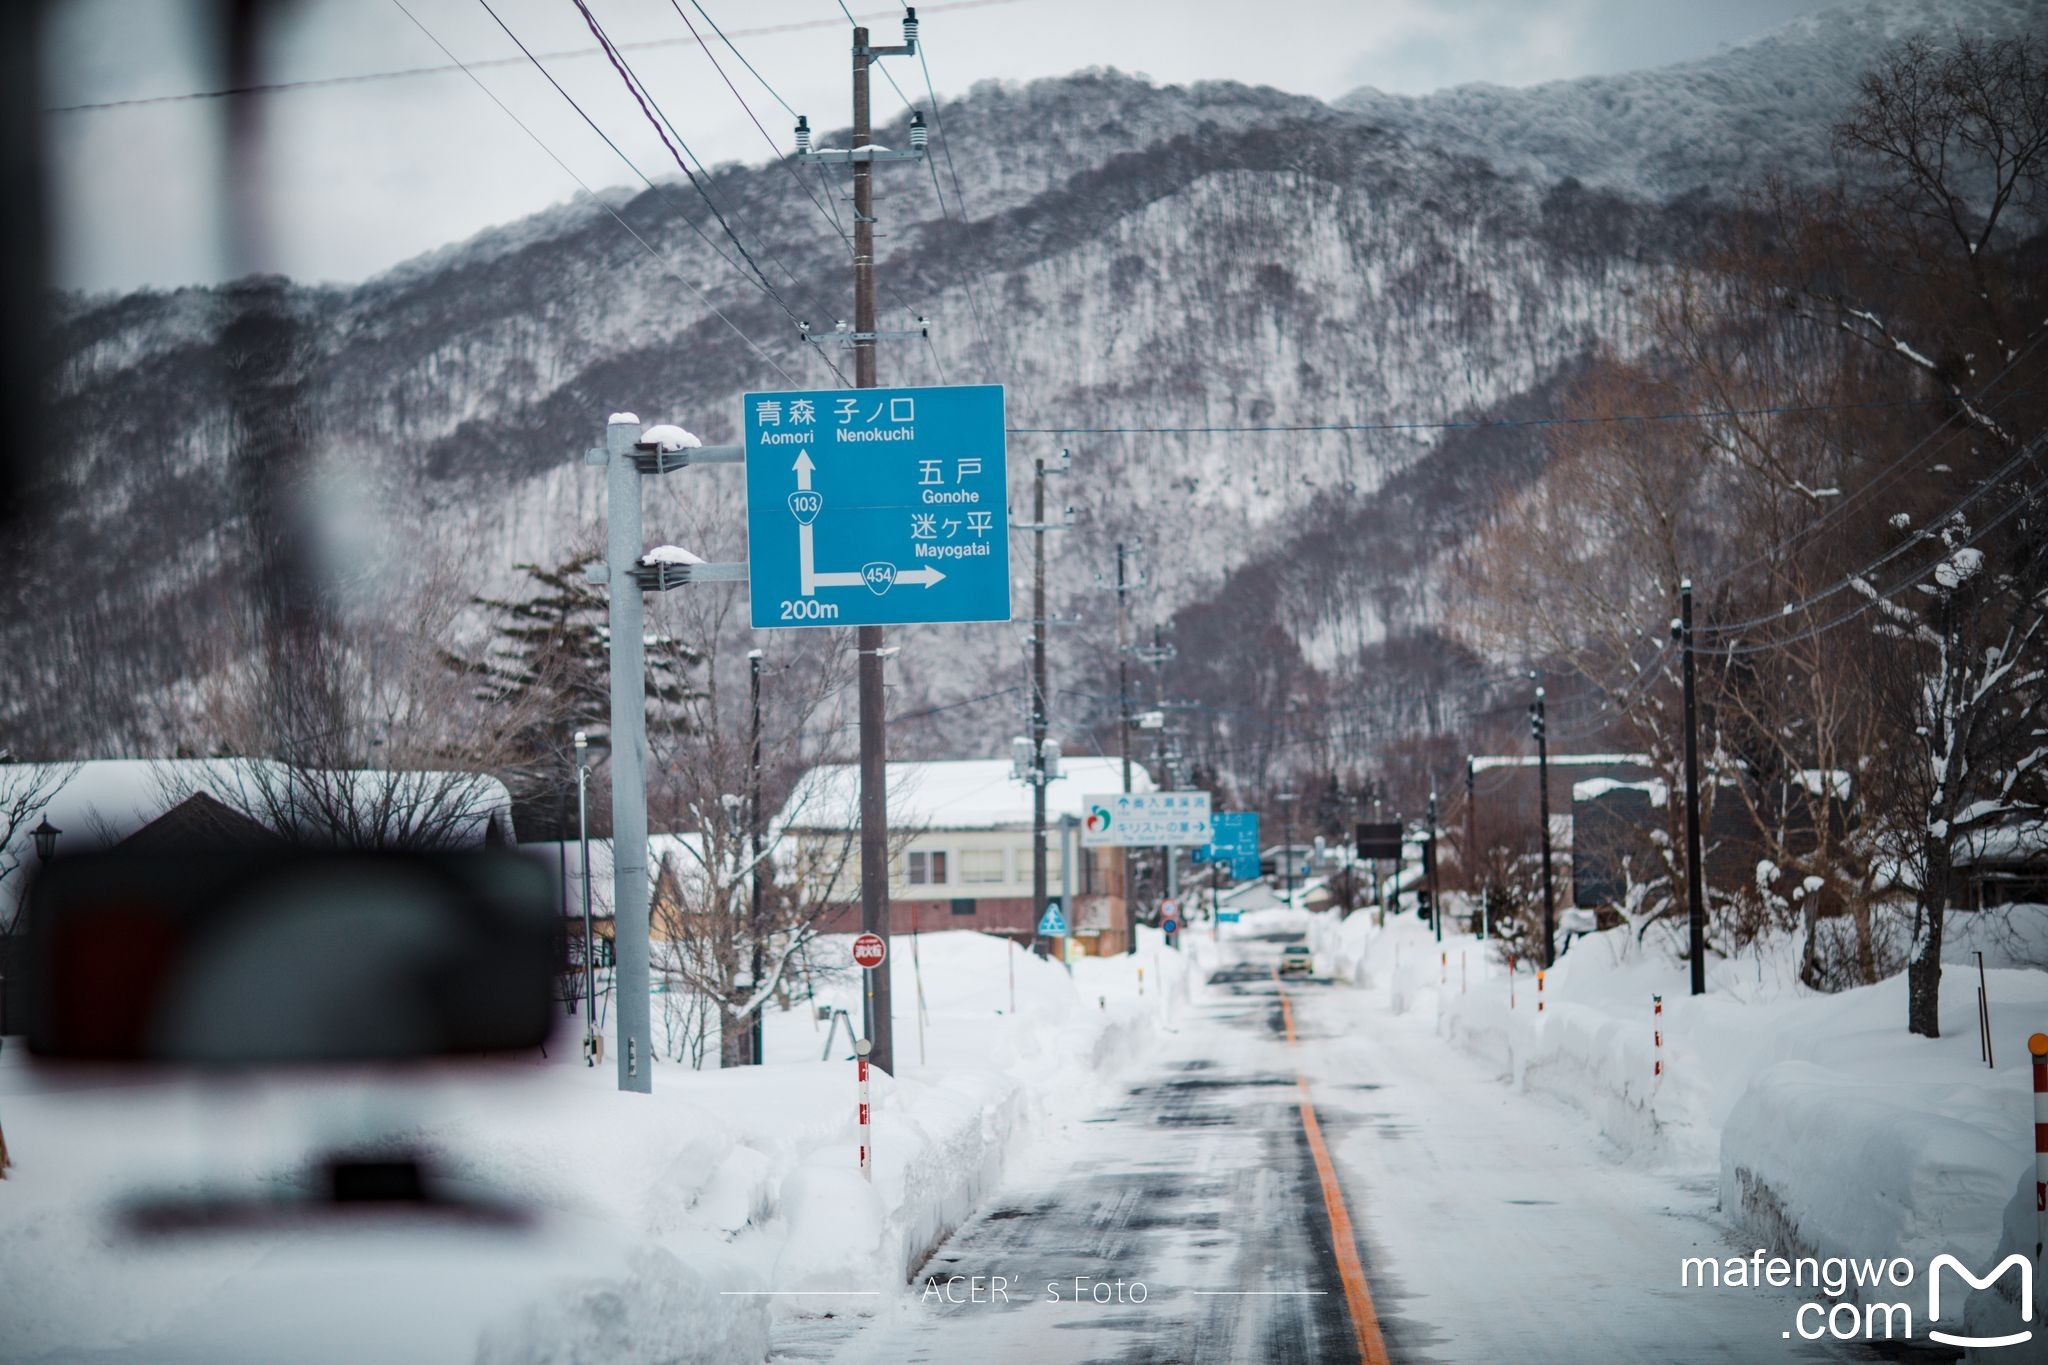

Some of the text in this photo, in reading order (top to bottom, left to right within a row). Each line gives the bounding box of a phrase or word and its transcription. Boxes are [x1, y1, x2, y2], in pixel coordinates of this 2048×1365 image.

[756, 398, 915, 426] 青森 子ノ口
[760, 427, 914, 445] Aomori Nenokuchi
[918, 458, 982, 486] 五戸
[793, 497, 818, 512] 103
[922, 489, 979, 504] Gonohe
[915, 542, 990, 560] Mayogatai
[866, 567, 892, 582] 454
[780, 600, 839, 620] 200m
[1117, 821, 1190, 833] キリストの
